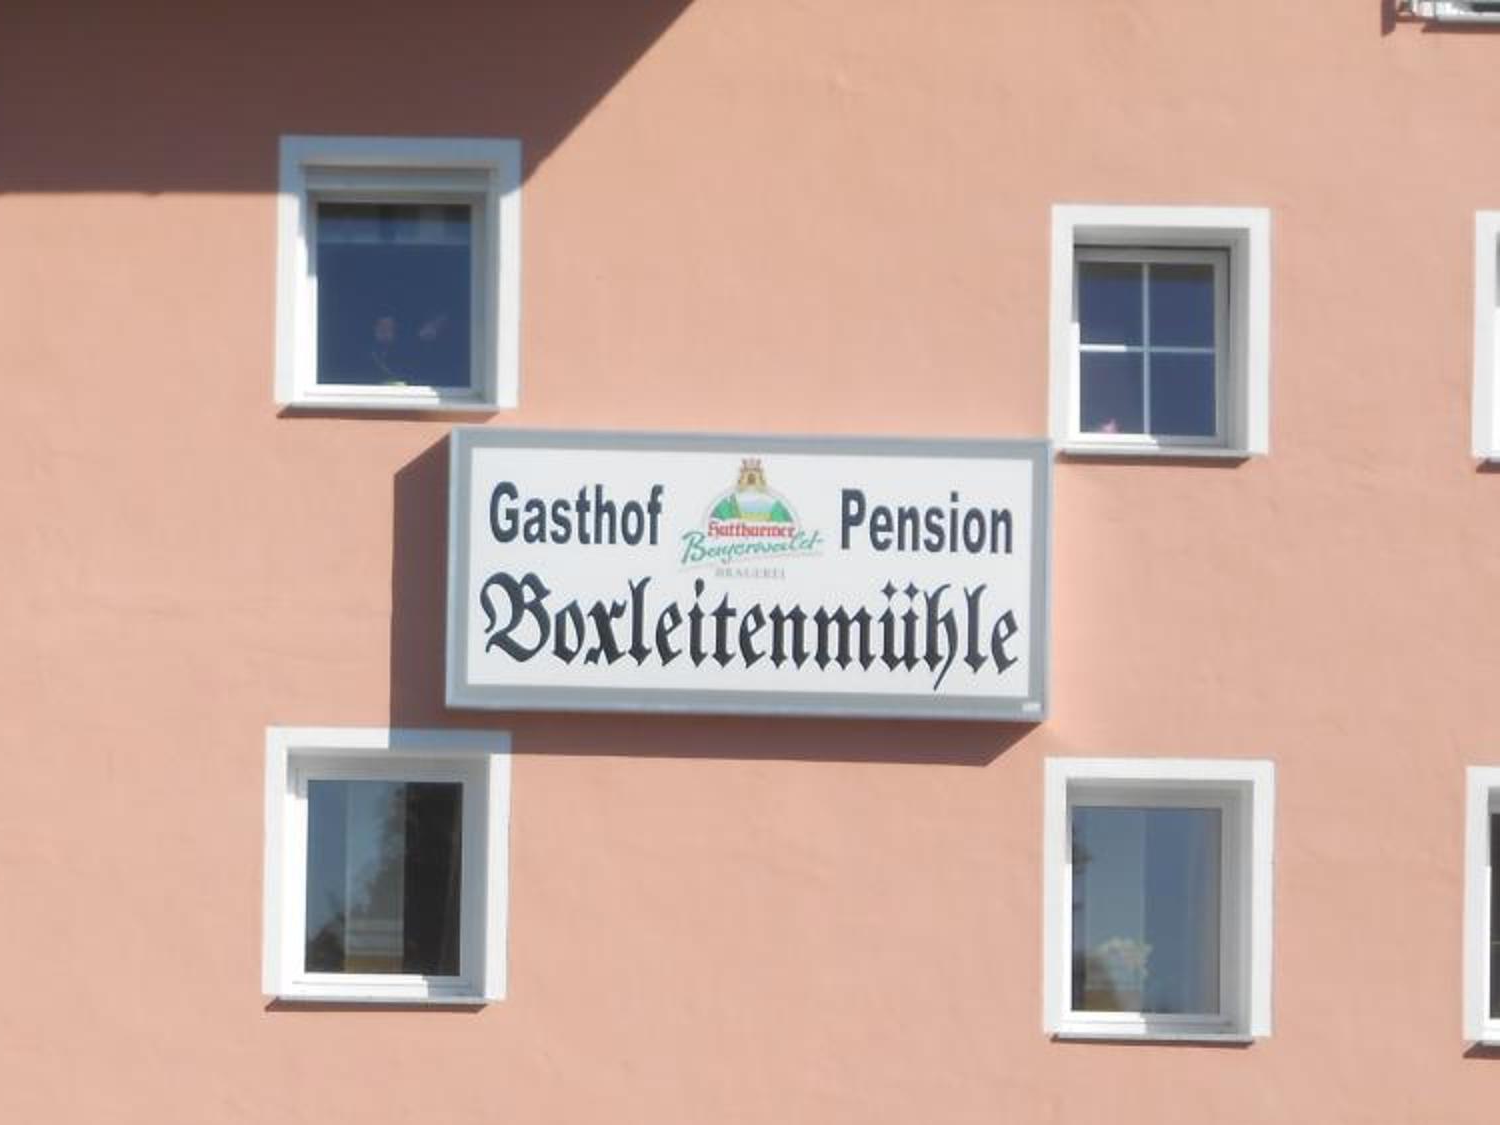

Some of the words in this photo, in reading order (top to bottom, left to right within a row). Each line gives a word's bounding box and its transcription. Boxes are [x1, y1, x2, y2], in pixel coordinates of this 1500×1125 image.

[489, 481, 664, 546] Gasthof
[841, 489, 1013, 554] Pension
[479, 571, 1019, 691] Boxleitenmühle
